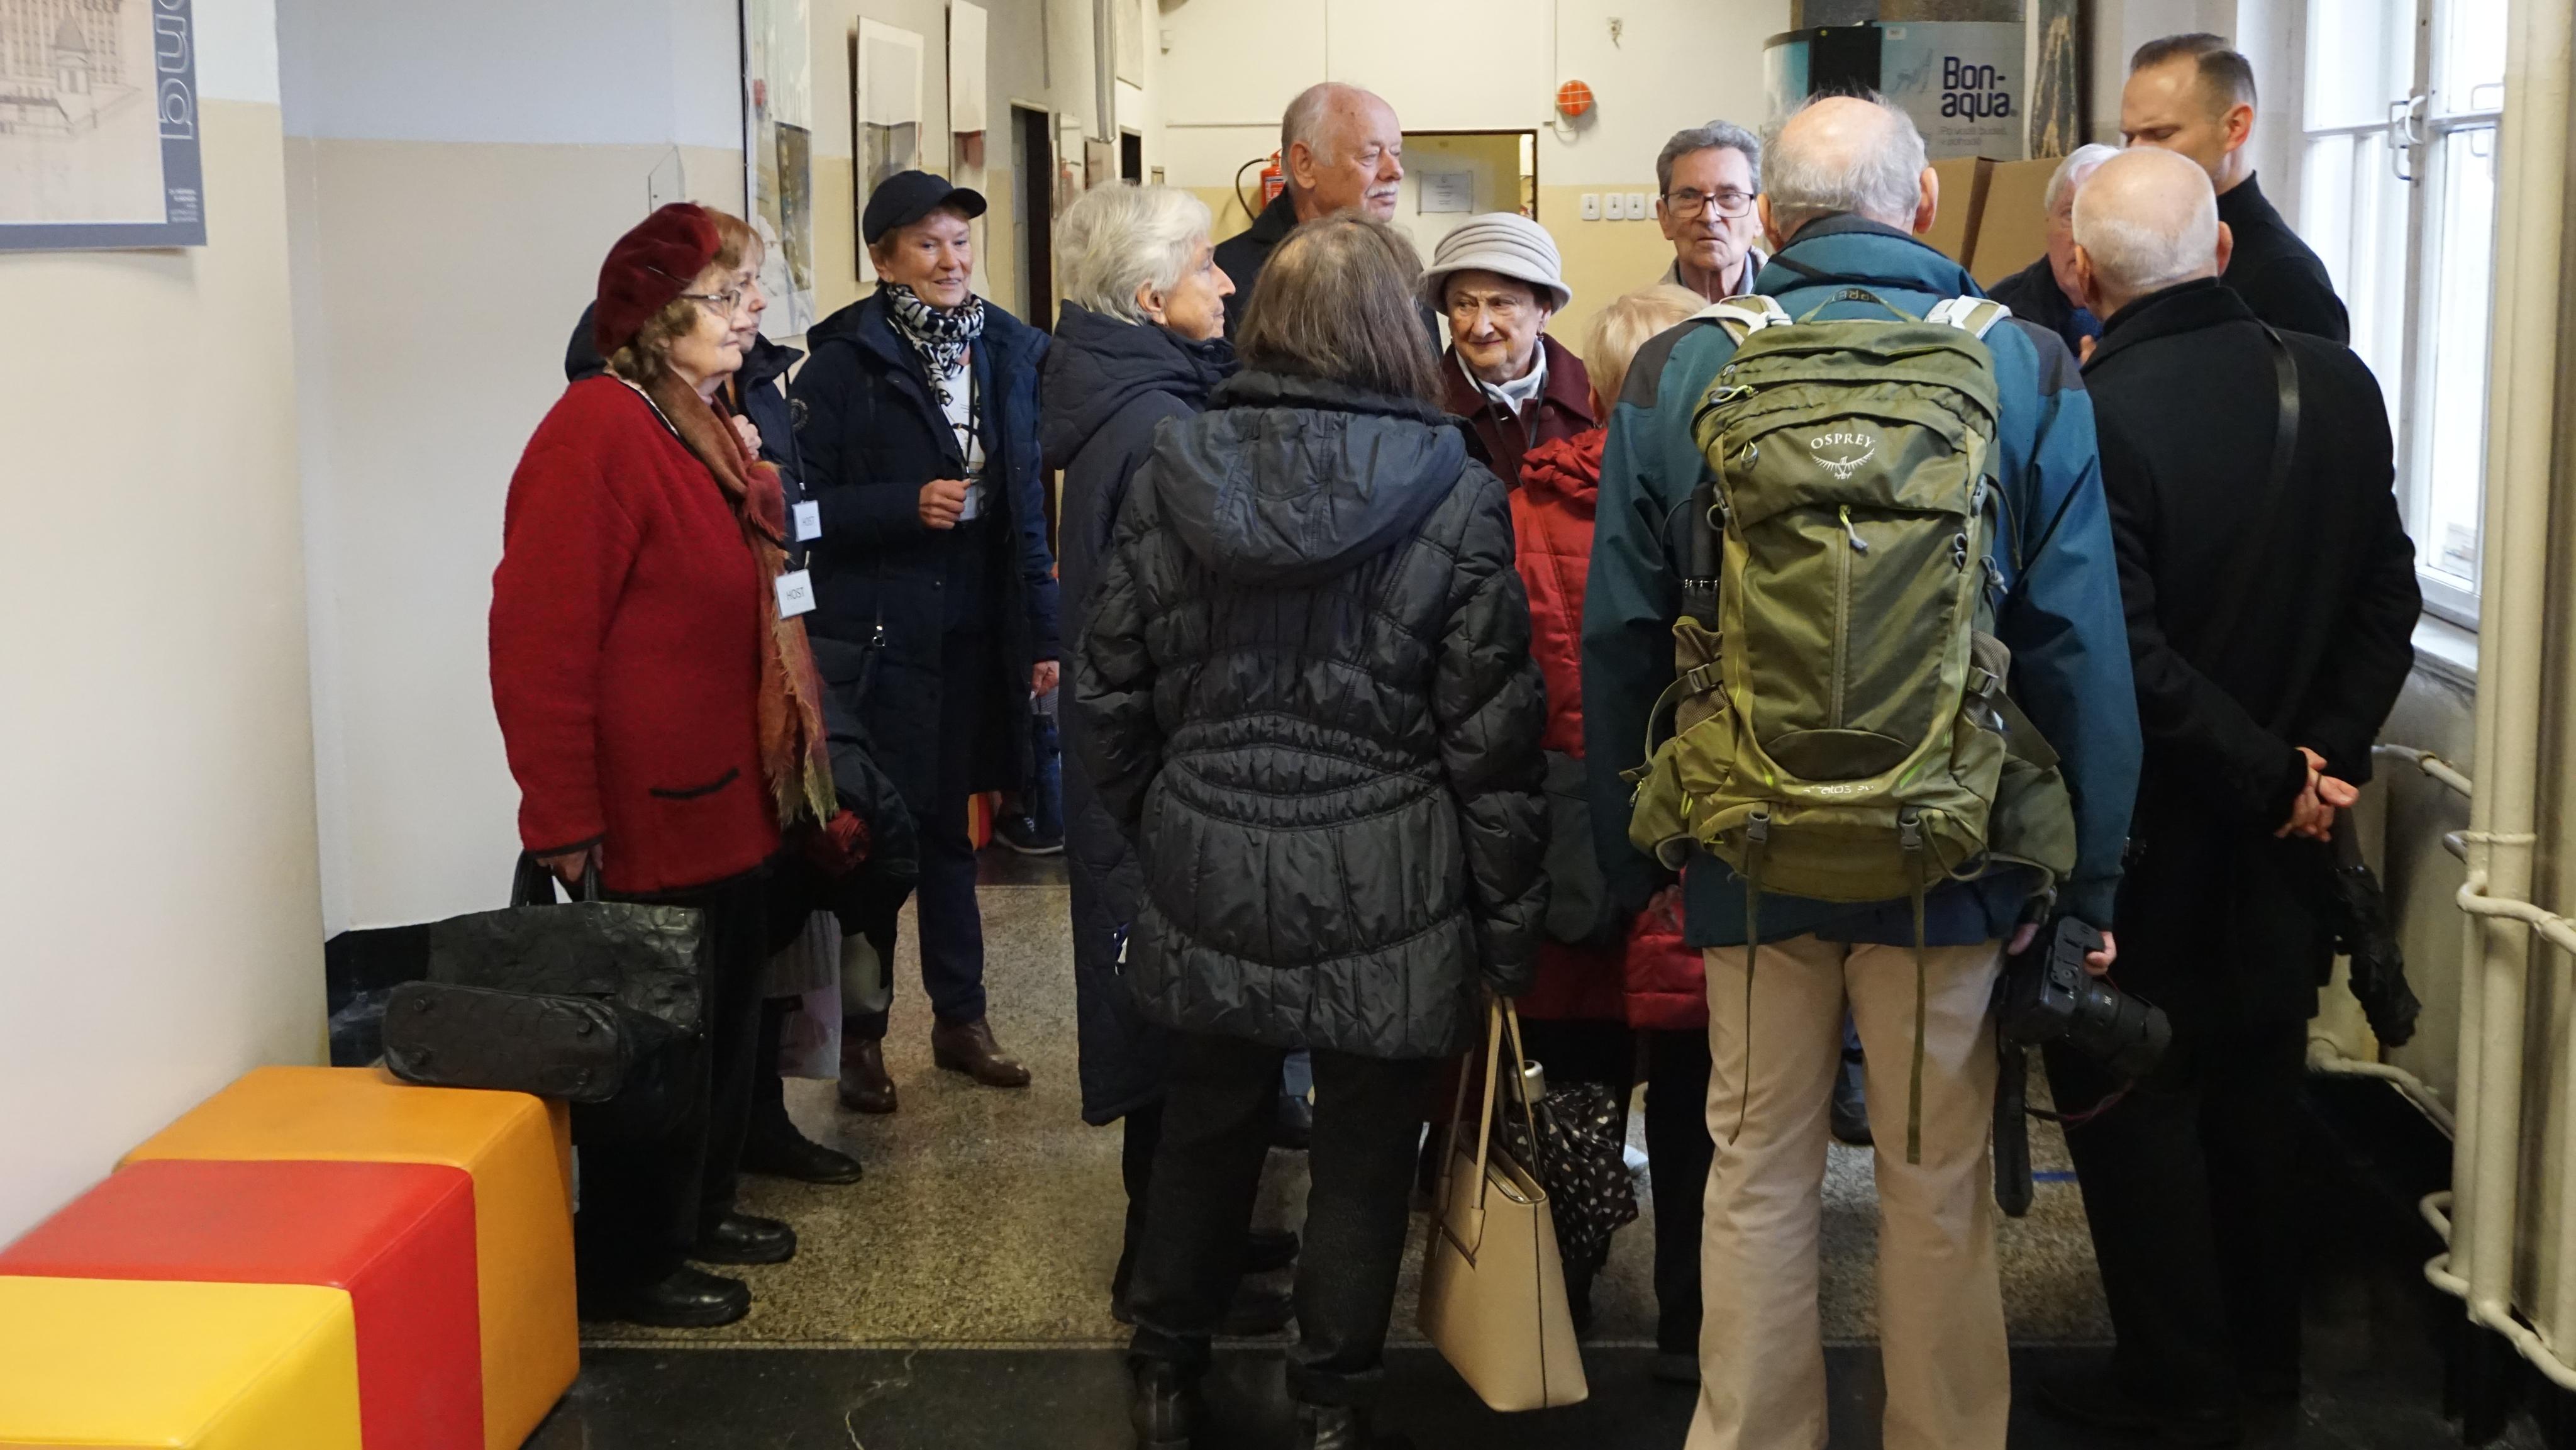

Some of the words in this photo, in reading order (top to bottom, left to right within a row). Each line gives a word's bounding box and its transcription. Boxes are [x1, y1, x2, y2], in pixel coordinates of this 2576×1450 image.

[1943, 56, 2006, 90] Bon-
[1811, 433, 1874, 449] OSPREY
[786, 586, 804, 601] HOST
